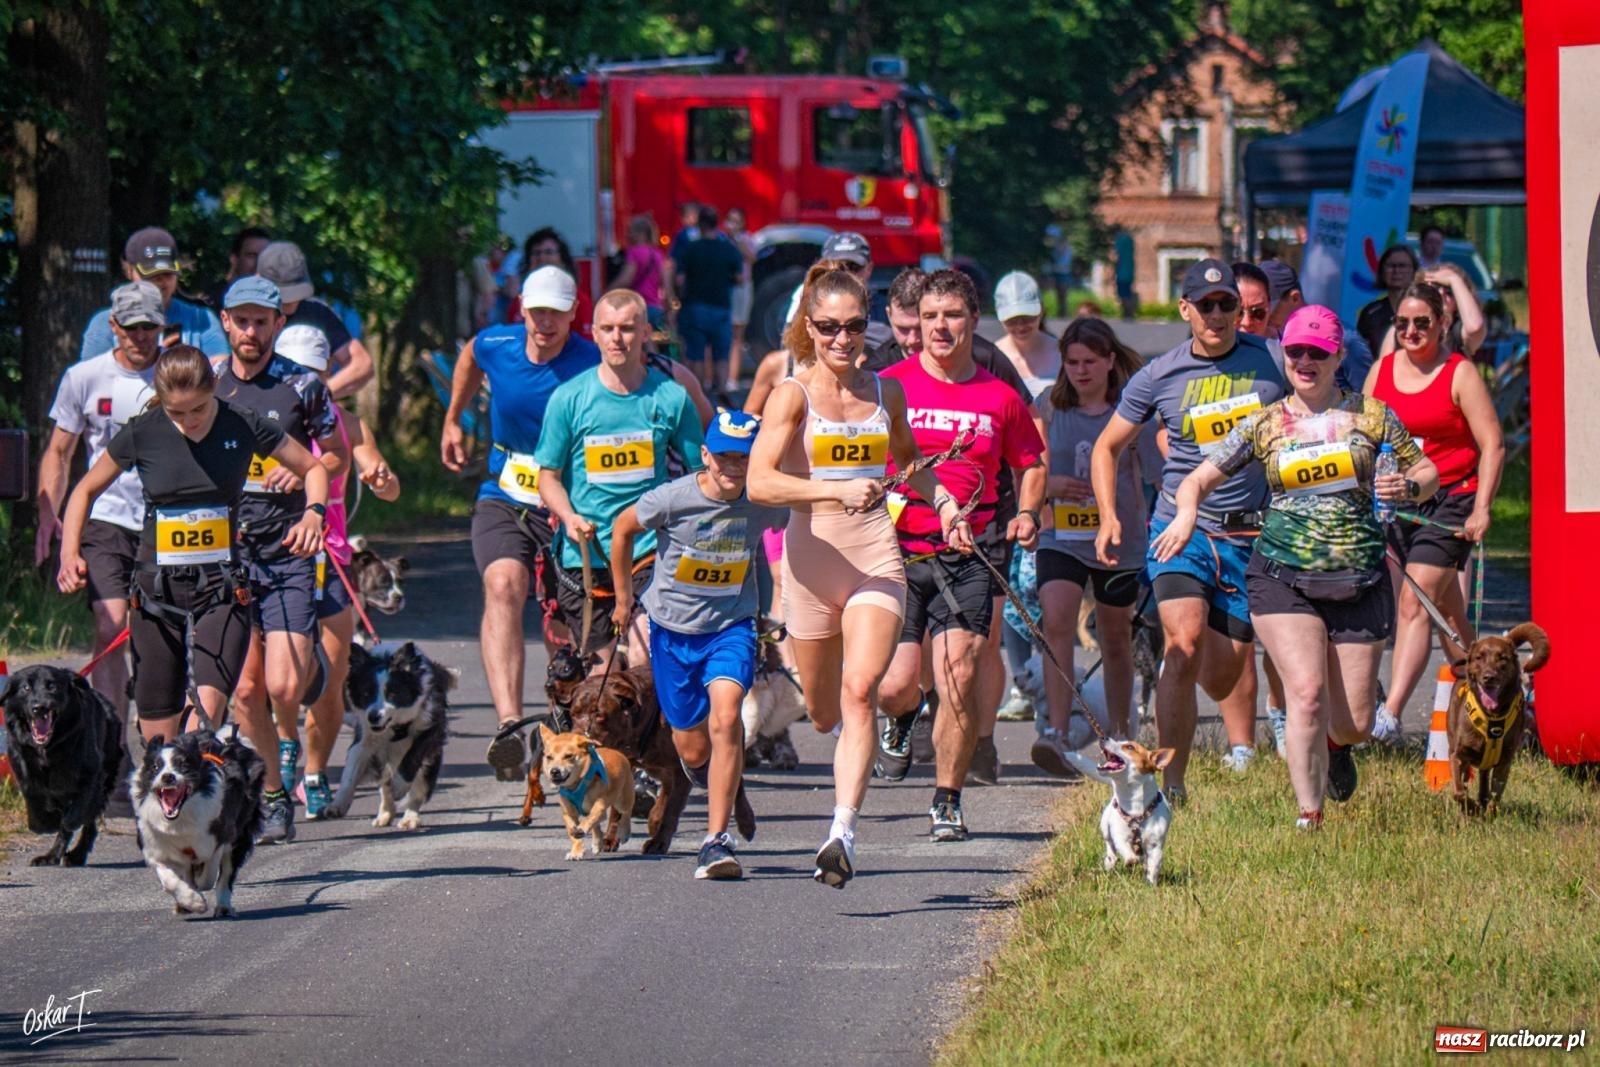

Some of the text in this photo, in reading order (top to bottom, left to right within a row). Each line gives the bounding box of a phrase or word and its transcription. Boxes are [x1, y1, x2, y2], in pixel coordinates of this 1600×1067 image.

[1210, 414, 1247, 437] 01
[600, 450, 640, 468] 001
[831, 444, 872, 462] 021
[1296, 462, 1339, 484] 020
[1067, 512, 1100, 527] 023
[171, 529, 215, 547] 026
[693, 568, 732, 583] 031
